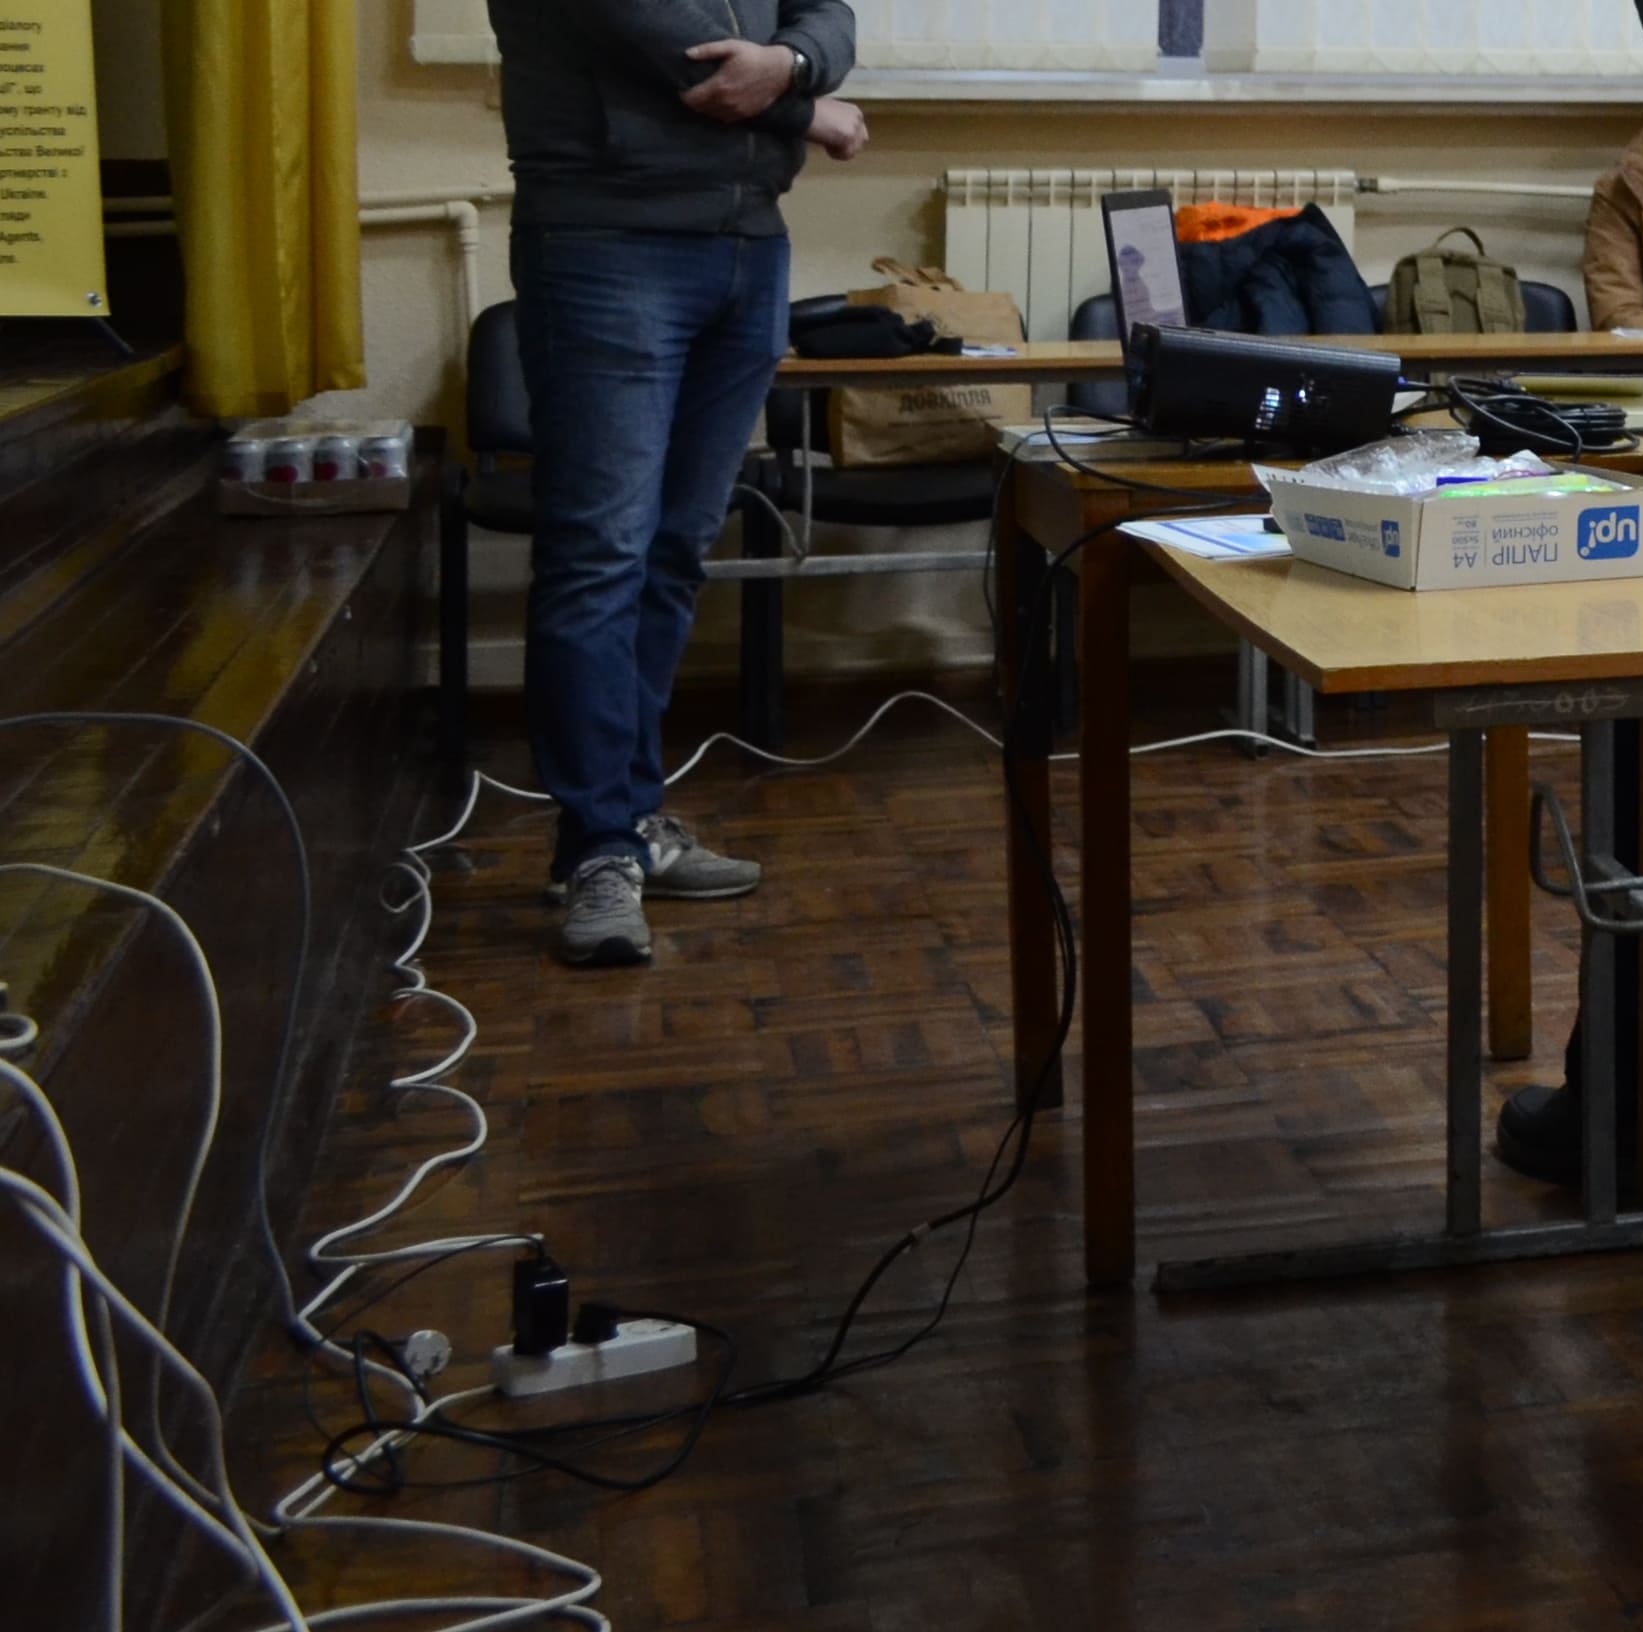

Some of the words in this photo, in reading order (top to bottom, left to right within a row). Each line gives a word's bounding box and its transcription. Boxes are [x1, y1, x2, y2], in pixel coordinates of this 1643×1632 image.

[899, 388, 992, 414] ДОВКІЛЛЯ
[1491, 522, 1559, 544] офісний
[1491, 542, 1559, 566] ПАПІР
